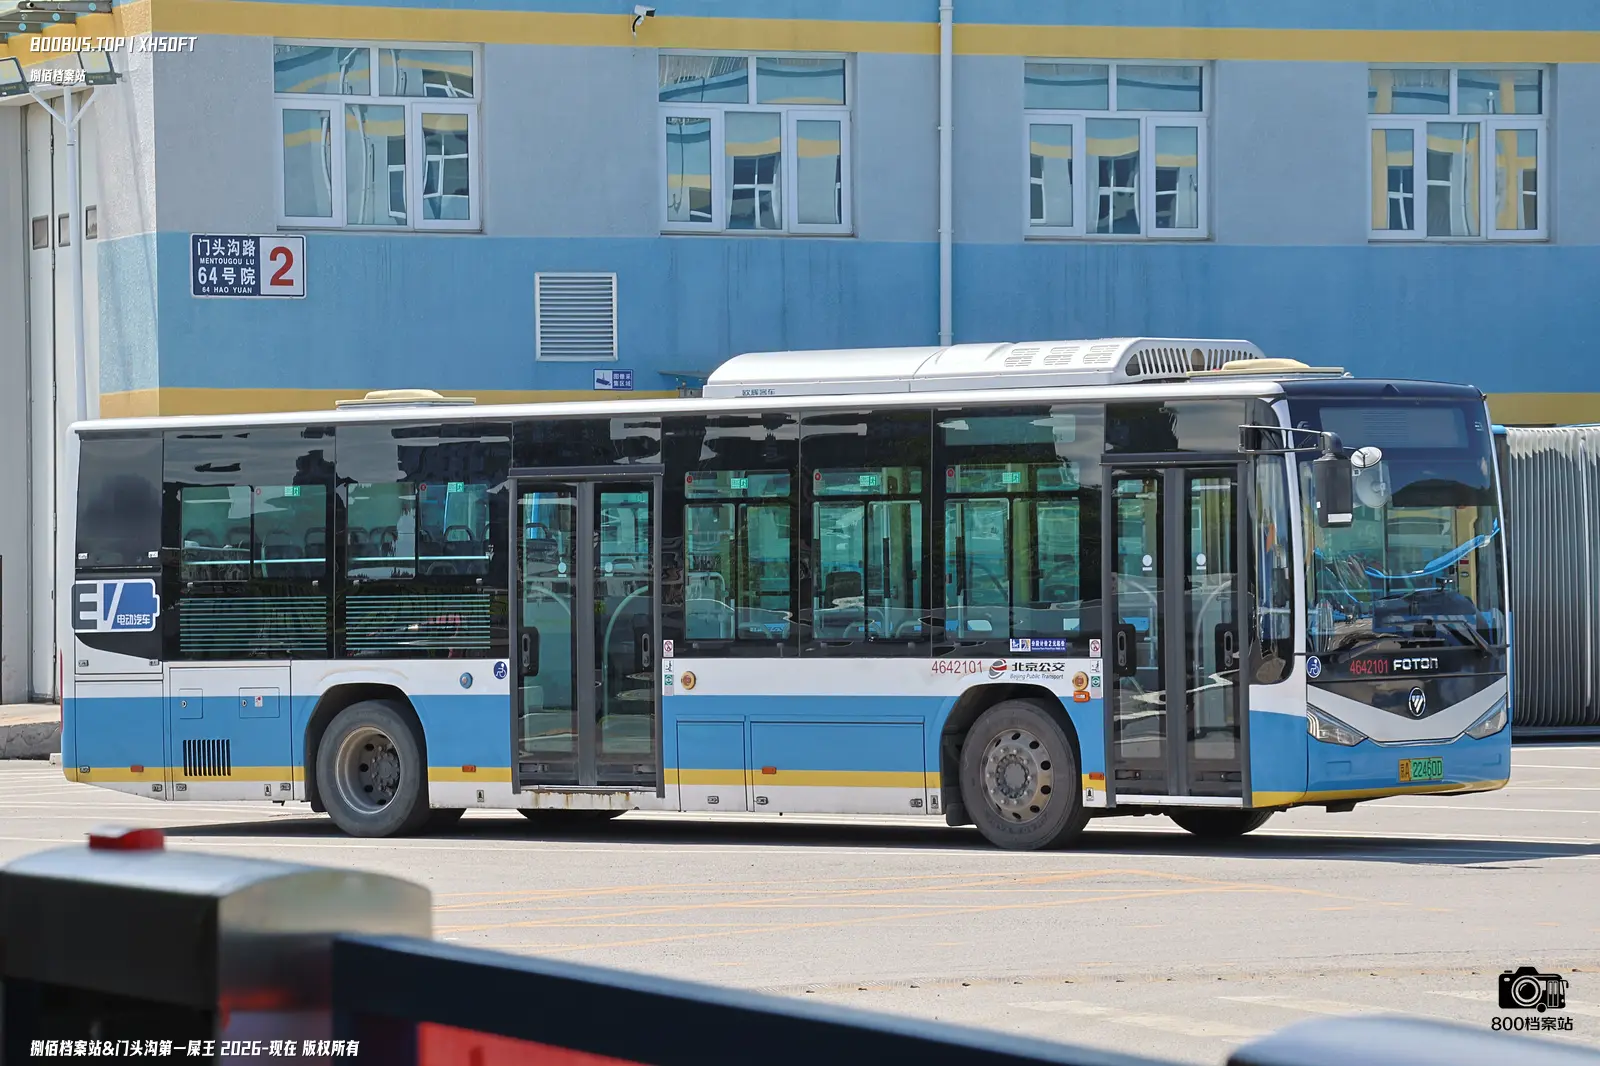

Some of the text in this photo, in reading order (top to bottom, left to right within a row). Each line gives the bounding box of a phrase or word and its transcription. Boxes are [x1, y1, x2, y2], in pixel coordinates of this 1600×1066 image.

[197, 238, 256, 257] 门头沟路
[200, 257, 242, 265] MENTOUGOU
[269, 246, 294, 286] 2
[198, 266, 256, 285] 64号院
[116, 613, 151, 625] 电动汽车
[931, 660, 983, 674] 4642101
[1011, 662, 1065, 672] 北京公交
[1350, 660, 1389, 674] 4642101
[1393, 657, 1438, 671] FOTON
